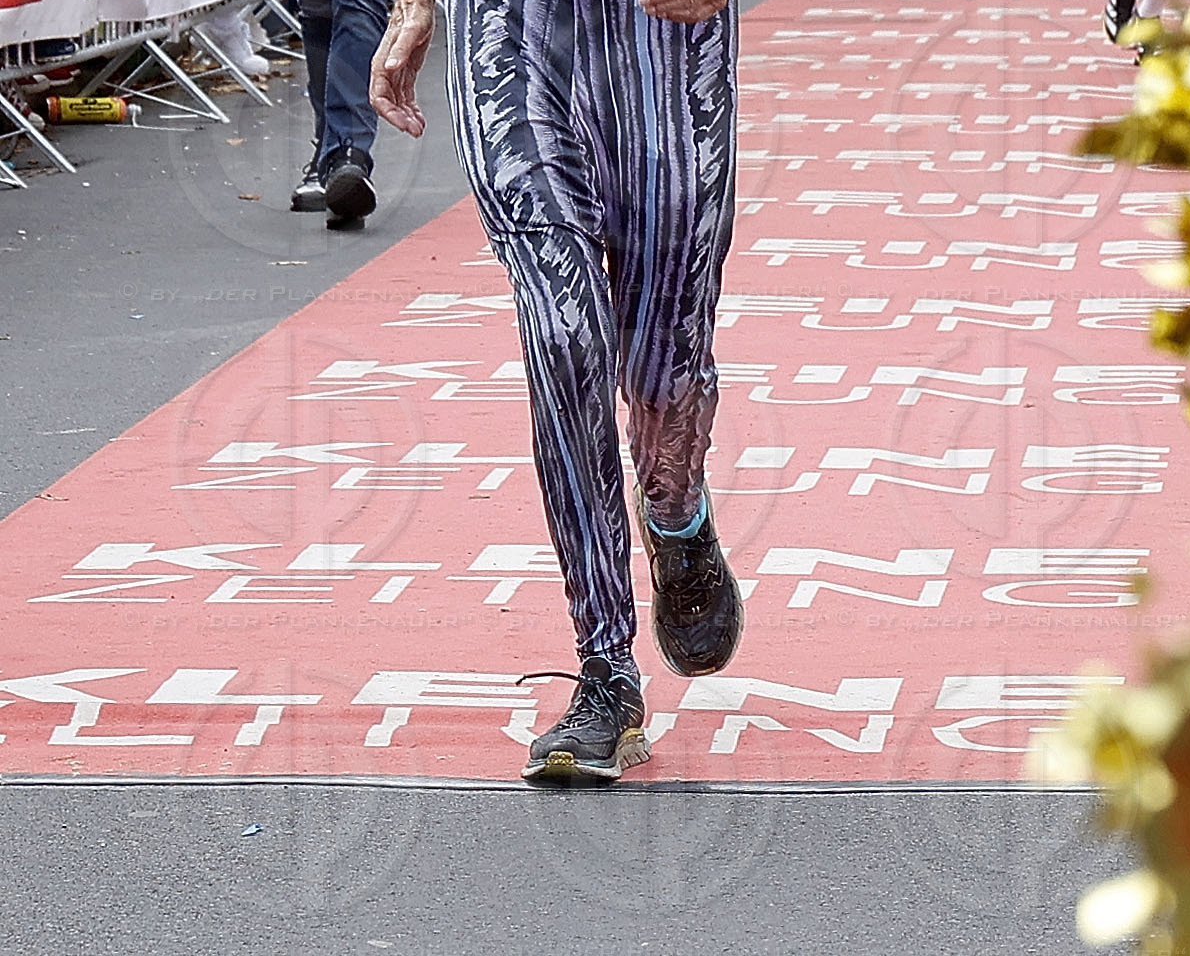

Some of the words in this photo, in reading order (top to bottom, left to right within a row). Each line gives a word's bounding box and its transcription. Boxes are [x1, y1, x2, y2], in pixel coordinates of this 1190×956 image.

[315, 360, 1187, 386] KINE
[286, 380, 1181, 406] ZEUNG
[205, 441, 1170, 470] KLINE
[169, 467, 1165, 496] ZEIUNG
[71, 543, 1151, 577] KLENE
[26, 574, 1140, 609] ZEITNG
